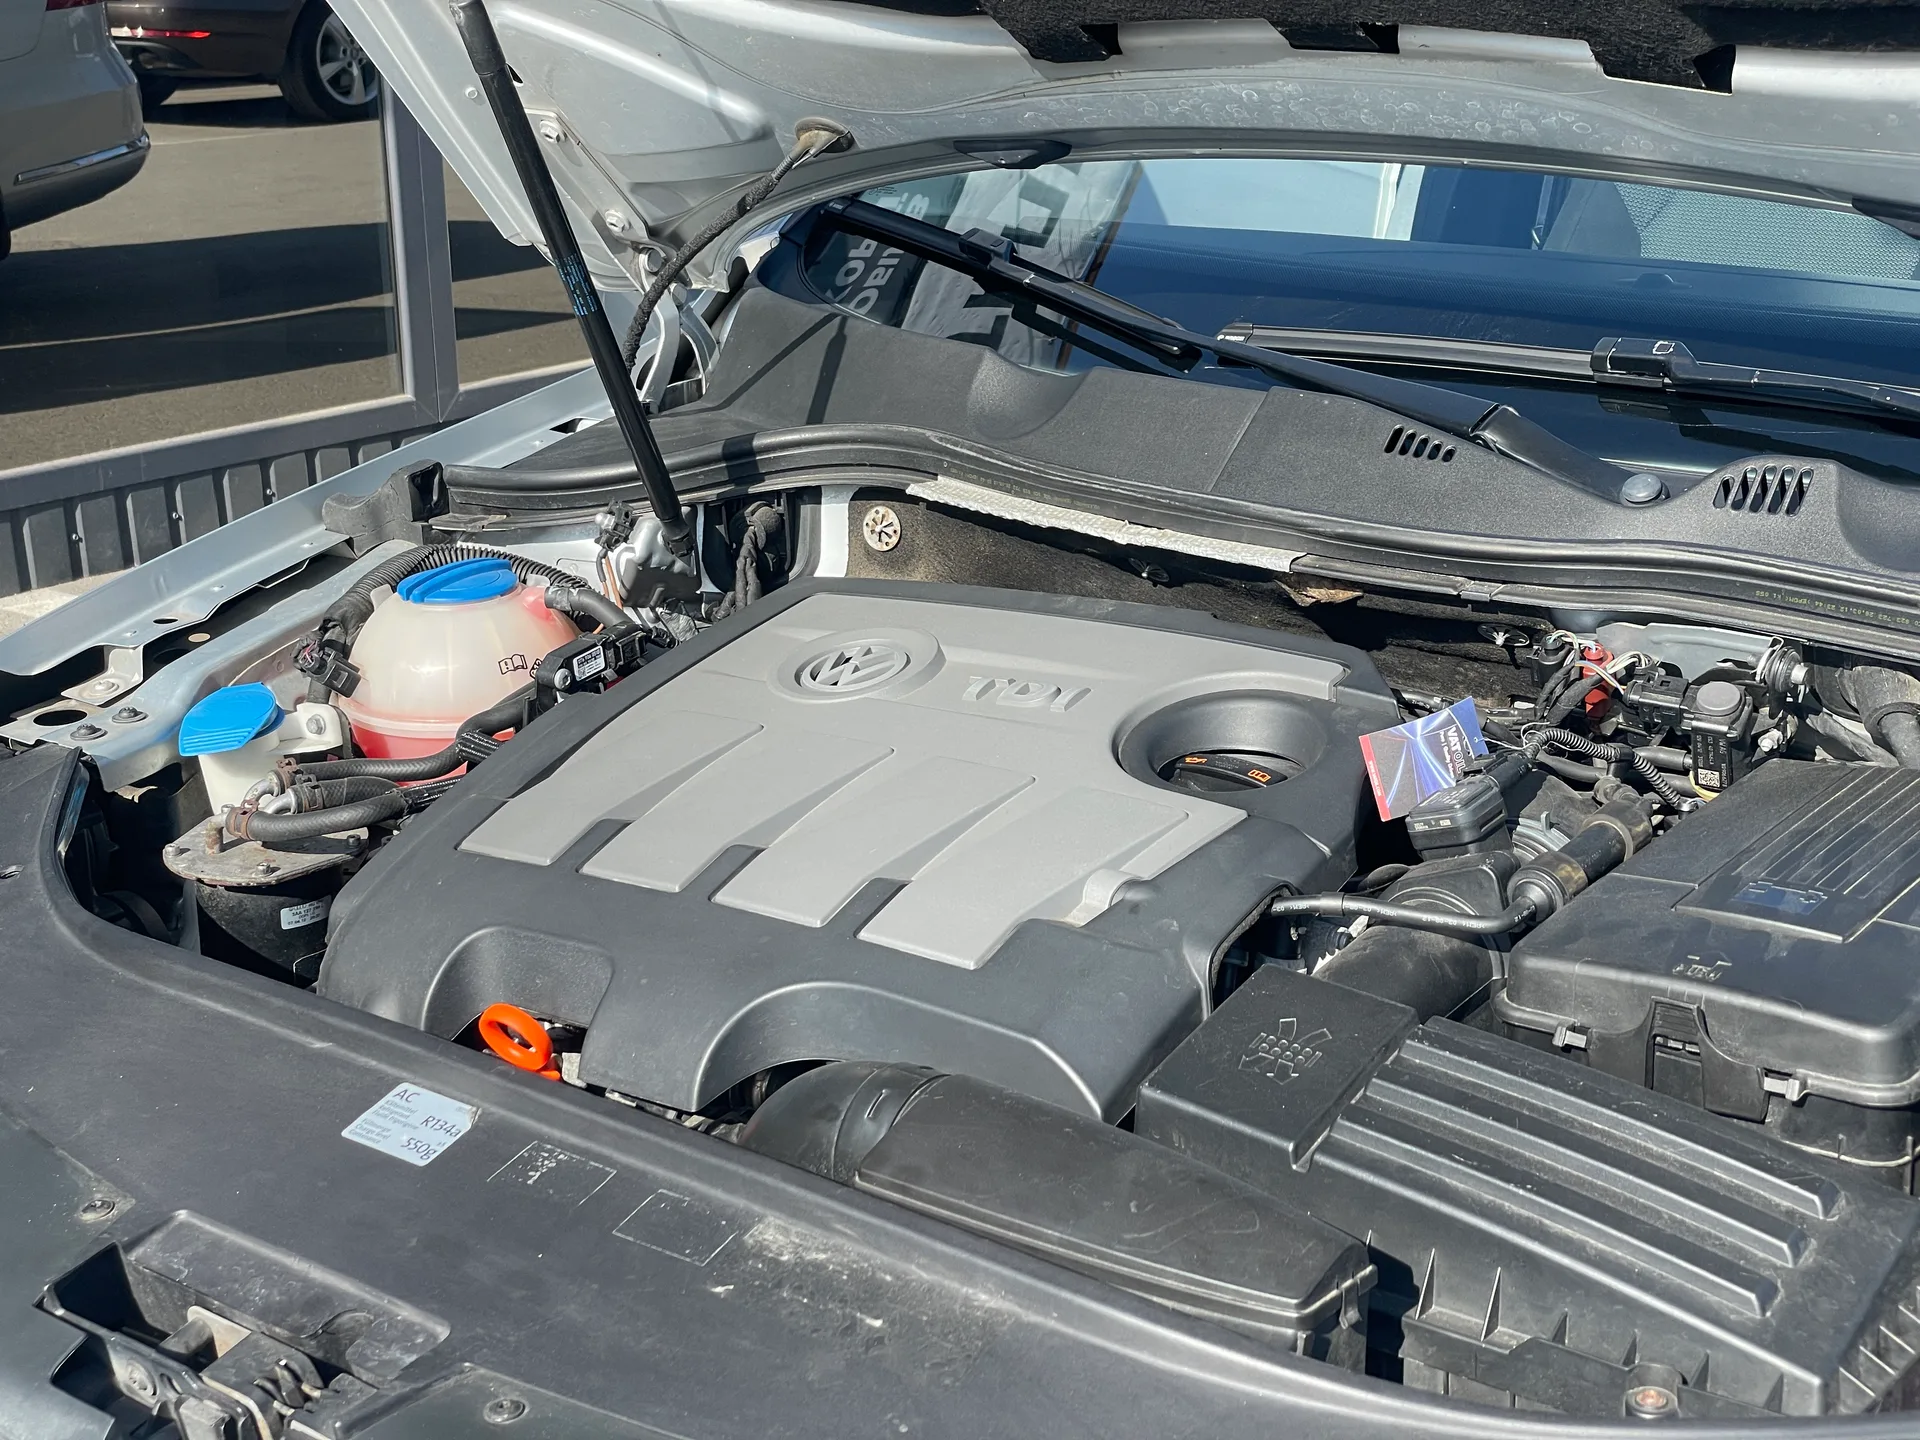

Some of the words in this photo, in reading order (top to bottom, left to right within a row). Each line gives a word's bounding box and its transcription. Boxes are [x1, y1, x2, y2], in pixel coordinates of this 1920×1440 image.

[962, 676, 1094, 713] TDI
[1448, 726, 1466, 774] VATOIL
[393, 1089, 420, 1103] AC
[420, 1115, 461, 1137] R134a
[400, 1137, 437, 1160] 550g
